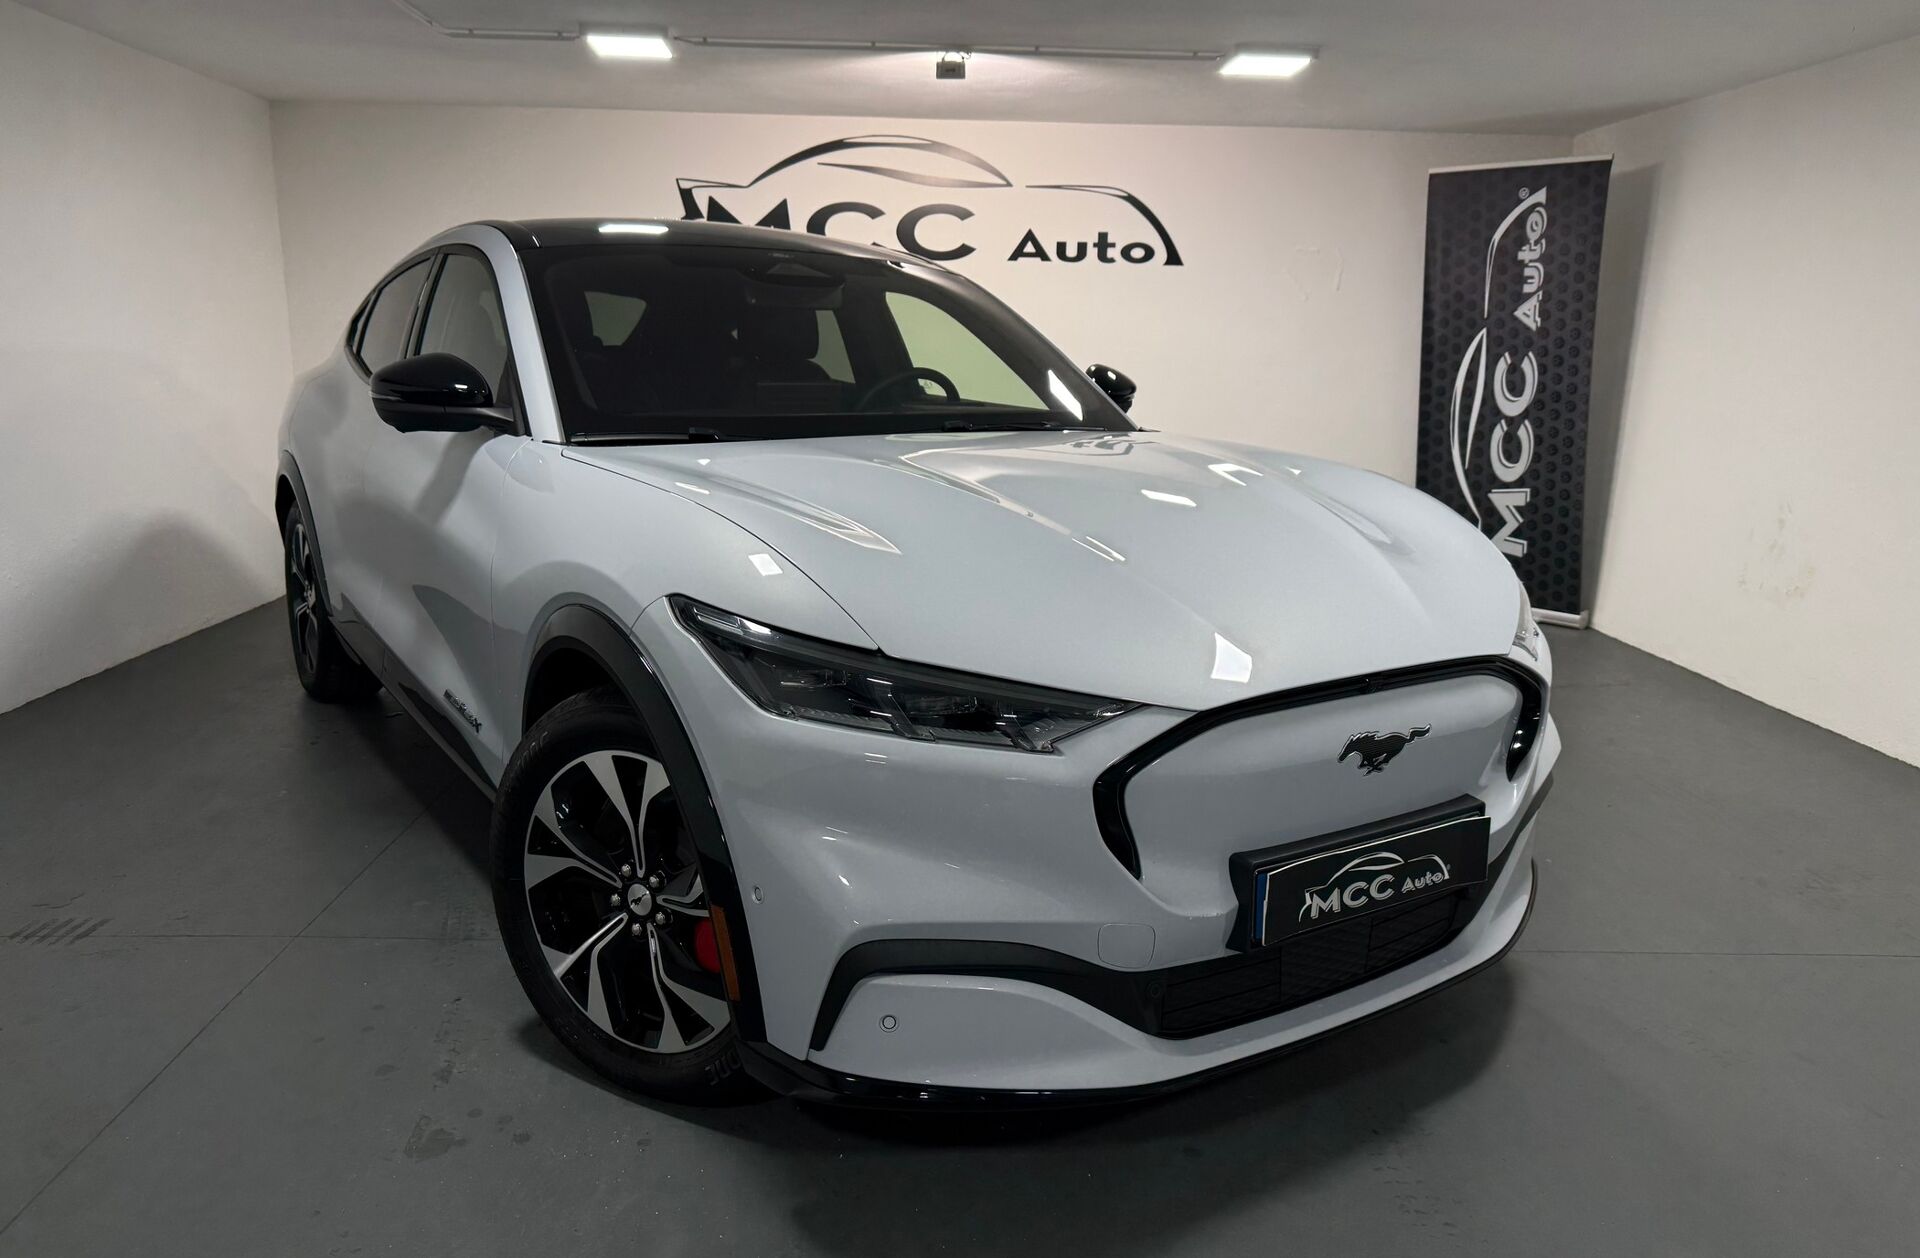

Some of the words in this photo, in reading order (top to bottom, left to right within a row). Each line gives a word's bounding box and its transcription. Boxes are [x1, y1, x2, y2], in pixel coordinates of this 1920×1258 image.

[1008, 228, 1155, 263] Auto
[1487, 351, 1538, 557] MCC
[1513, 206, 1548, 331] Auto
[1310, 873, 1395, 919] MCC
[1401, 871, 1444, 894] Auto
